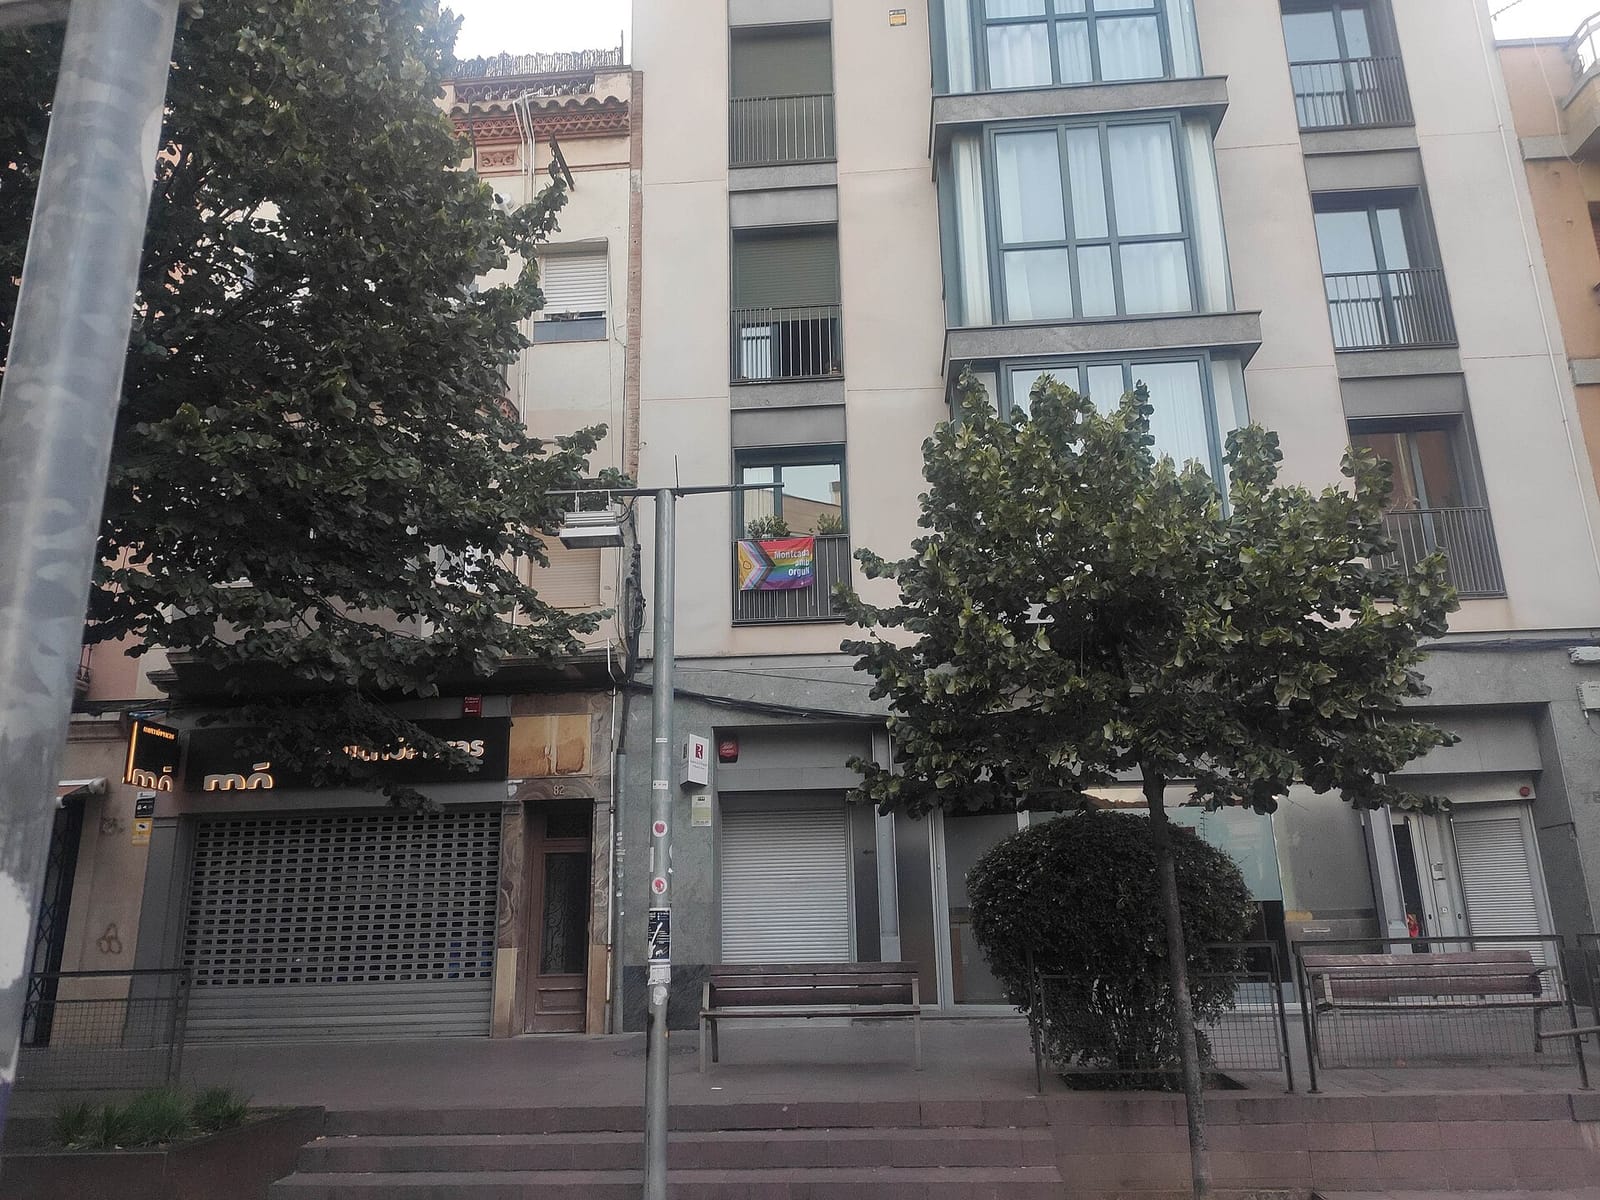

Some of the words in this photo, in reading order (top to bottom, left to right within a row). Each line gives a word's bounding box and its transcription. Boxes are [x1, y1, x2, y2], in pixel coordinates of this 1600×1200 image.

[774, 549, 810, 560] Montcada
[795, 559, 810, 567] amb
[553, 784, 565, 796] 82
